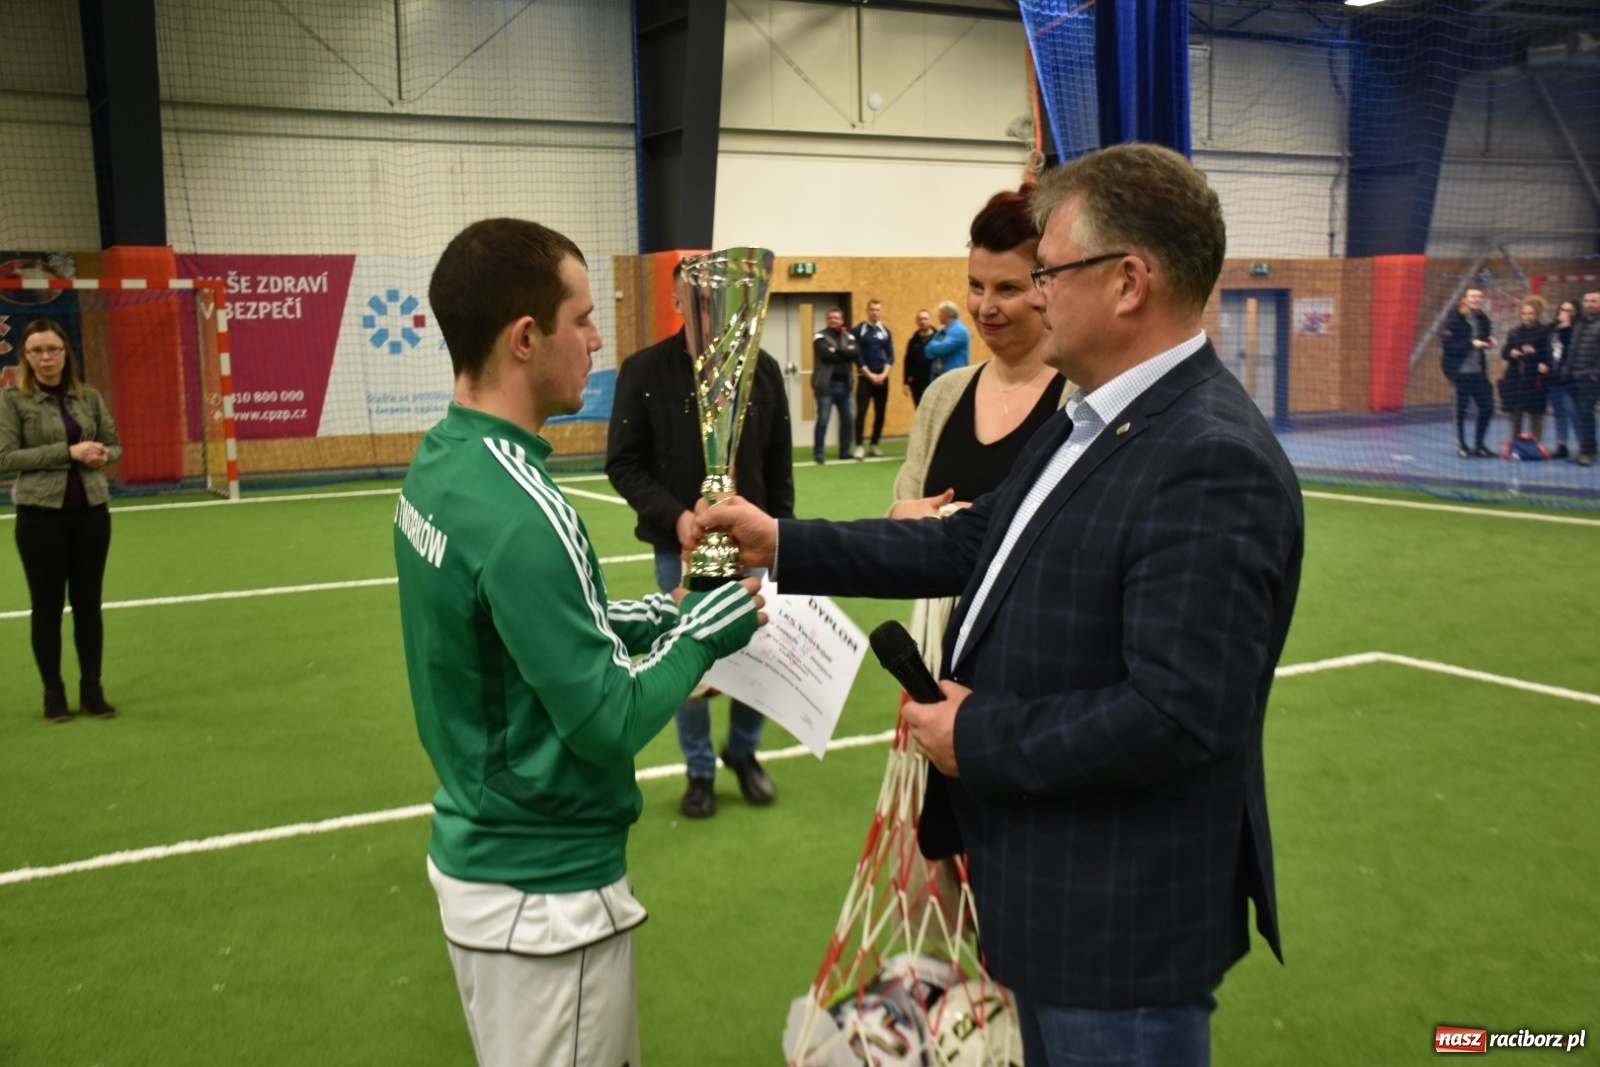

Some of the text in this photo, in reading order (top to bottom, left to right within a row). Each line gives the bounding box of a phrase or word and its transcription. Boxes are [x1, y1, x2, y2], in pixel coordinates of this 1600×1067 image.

[256, 271, 329, 293] ZDRAVÍ
[200, 297, 302, 320] V BEZPEČÍ
[254, 390, 278, 403] 800
[280, 389, 304, 402] 000
[808, 597, 858, 653] DYPLOM
